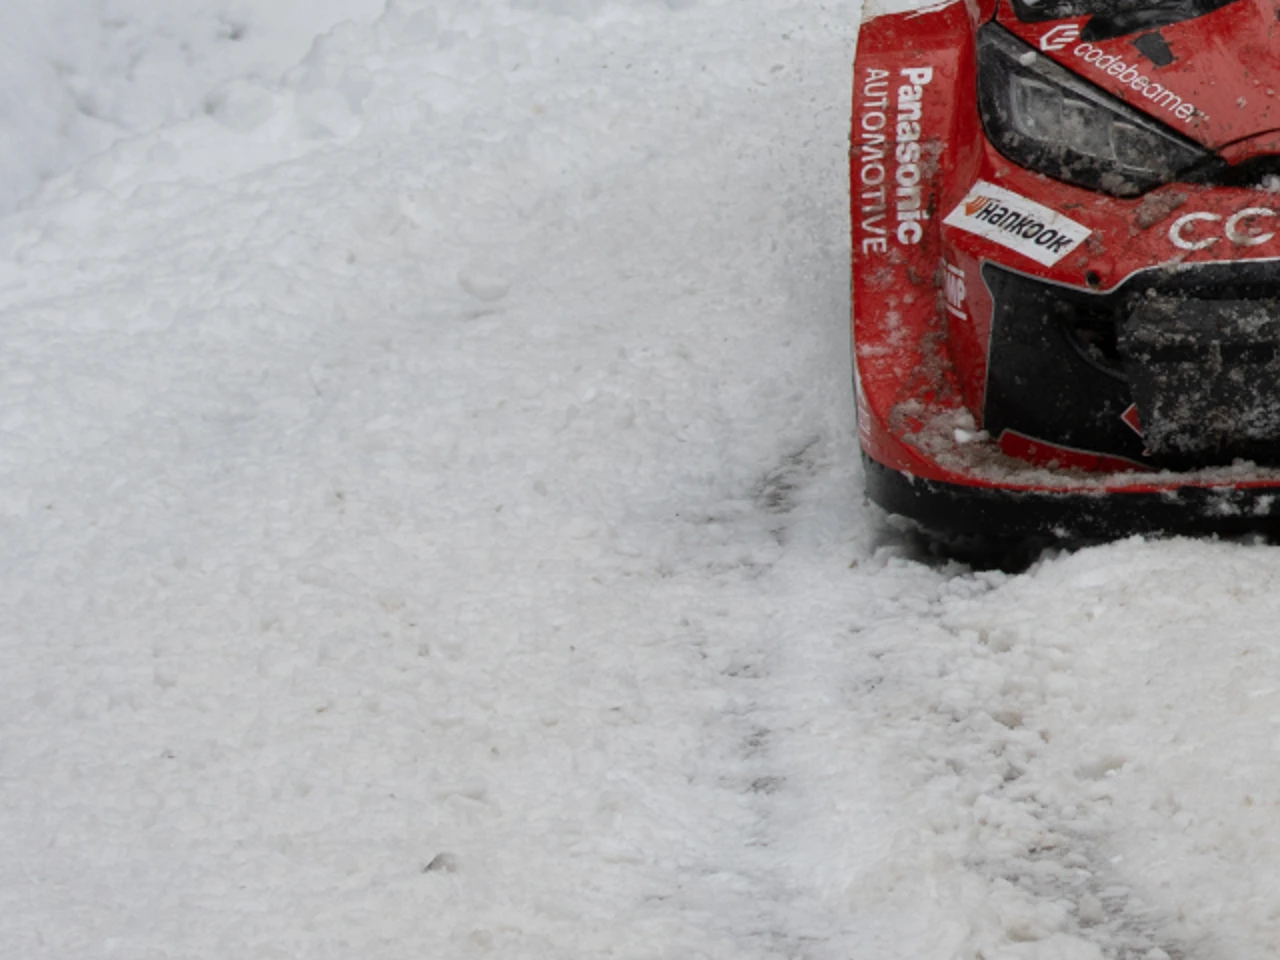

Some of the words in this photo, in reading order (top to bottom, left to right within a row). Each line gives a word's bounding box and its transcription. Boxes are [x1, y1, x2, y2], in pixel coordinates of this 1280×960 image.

[861, 67, 890, 255] AUTOMOTIVE
[896, 66, 933, 245] Panasonic
[1073, 40, 1204, 124] codebeamer
